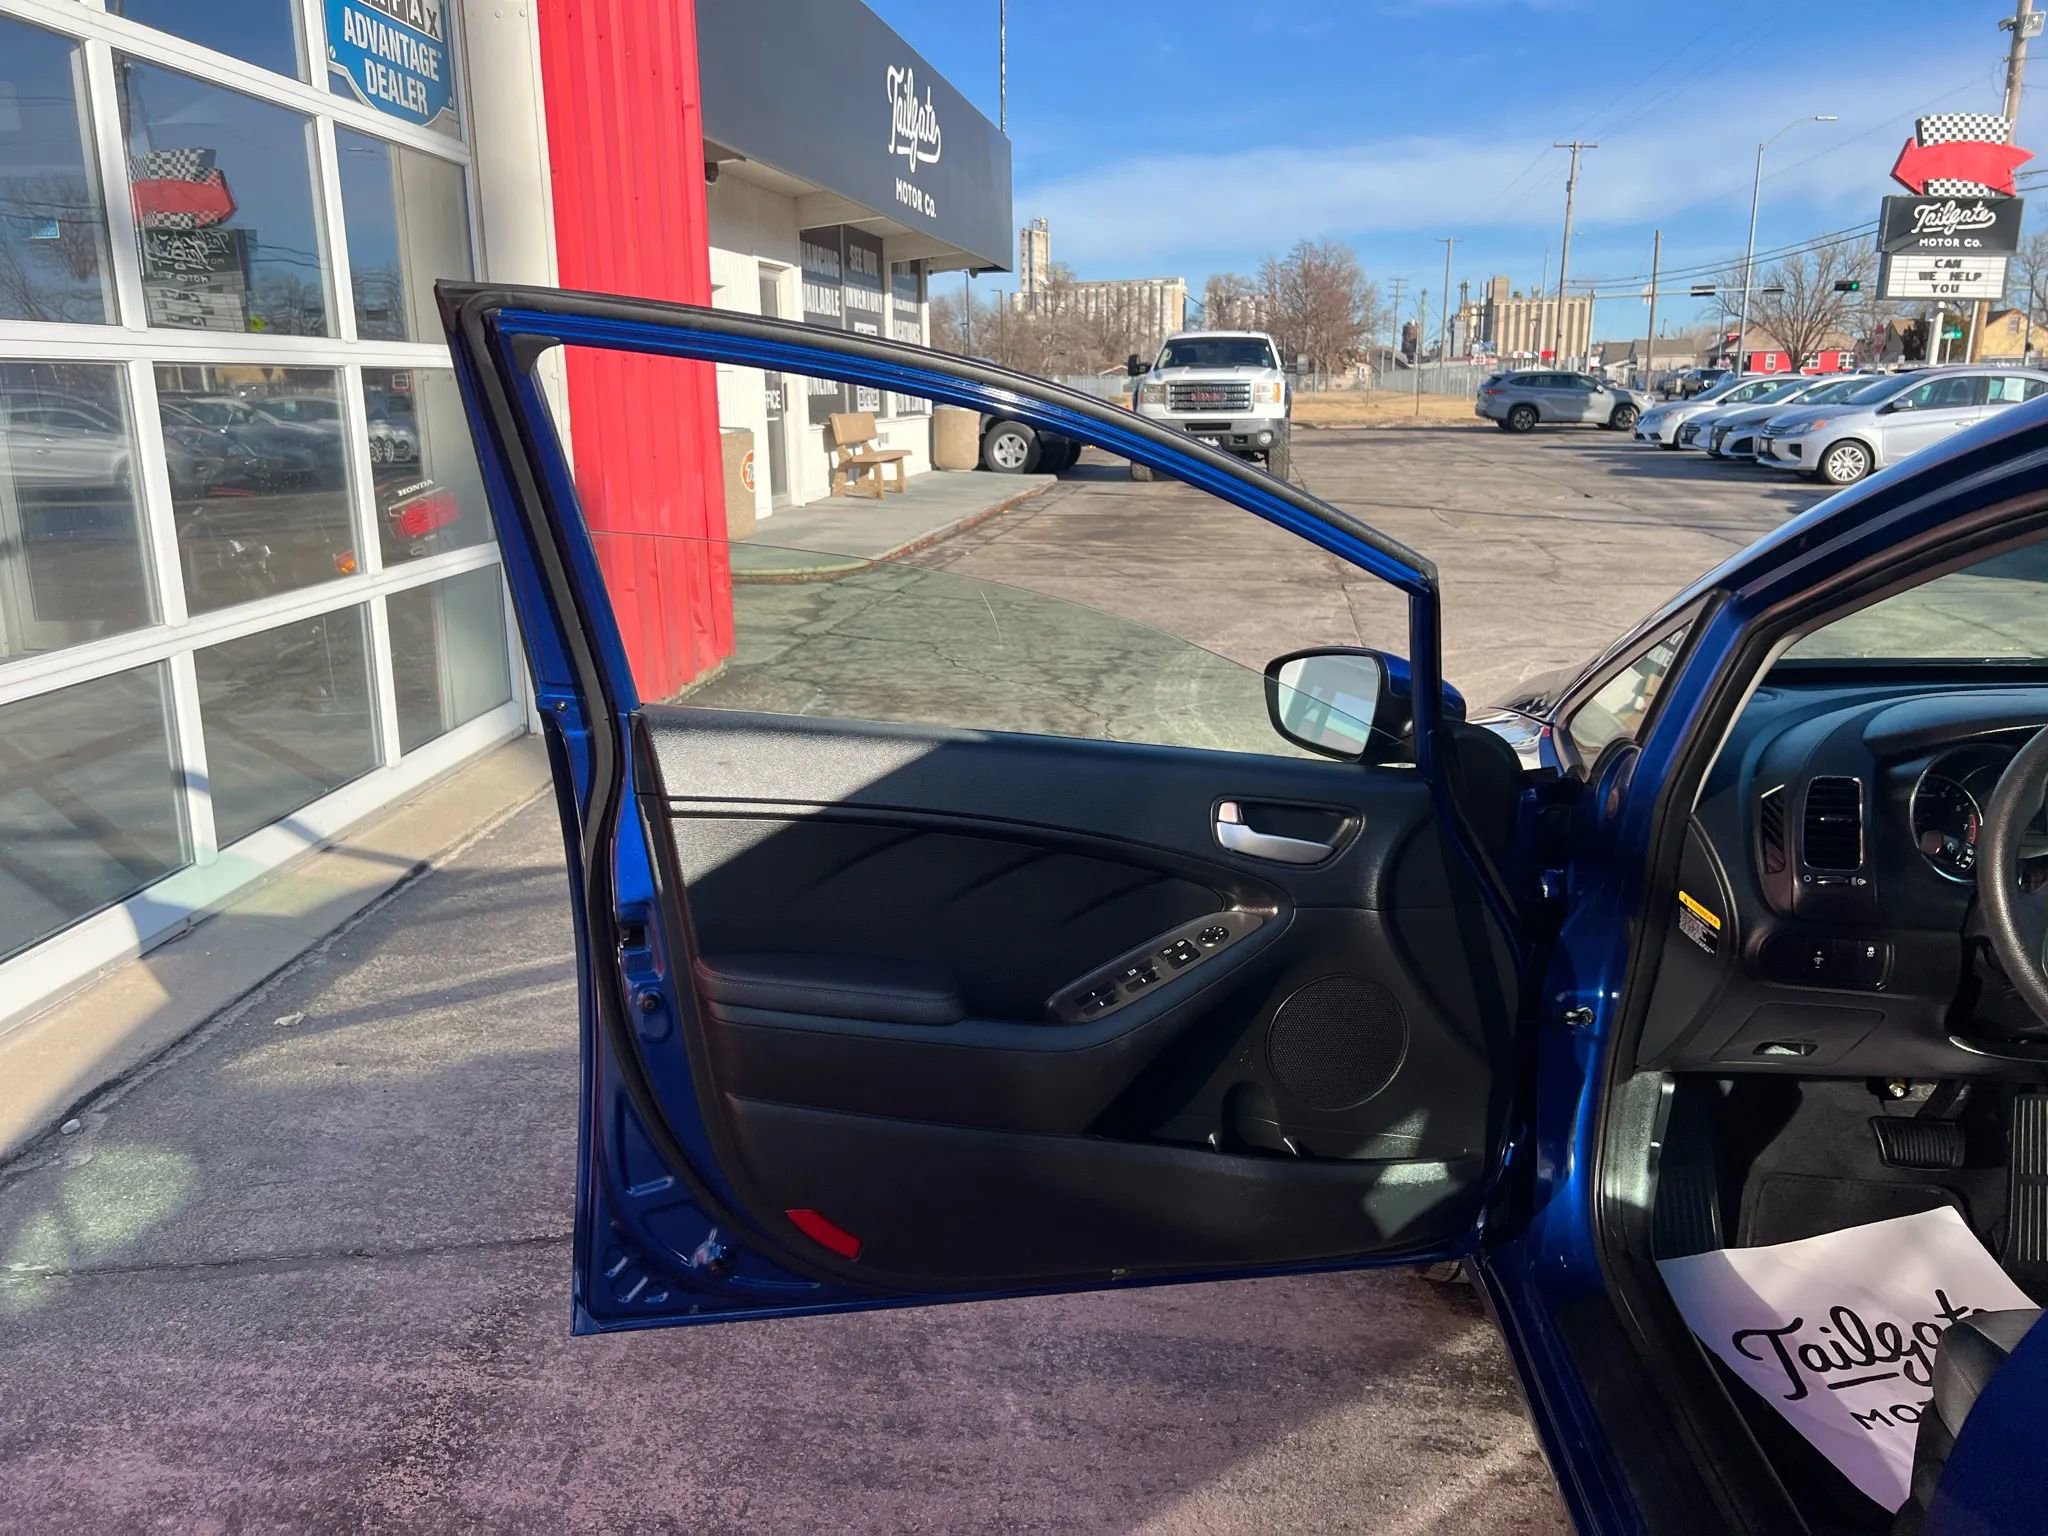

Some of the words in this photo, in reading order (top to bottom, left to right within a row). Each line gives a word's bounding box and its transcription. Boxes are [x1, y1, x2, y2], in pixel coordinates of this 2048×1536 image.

[344, 6, 440, 82] ADVANTAGE
[364, 58, 429, 116] DEALER
[887, 65, 942, 173] Tailgate
[895, 177, 923, 212] MOTOR
[1911, 200, 1996, 235] Tailgate
[1919, 238, 1960, 247] MOTOR
[1918, 271, 1936, 281] WE
[1949, 271, 1982, 282] HELP
[1934, 259, 1962, 269] CAN
[1931, 283, 1960, 294] YOU
[397, 479, 434, 497] HONDA
[1731, 1288, 1988, 1401] Tailgat
